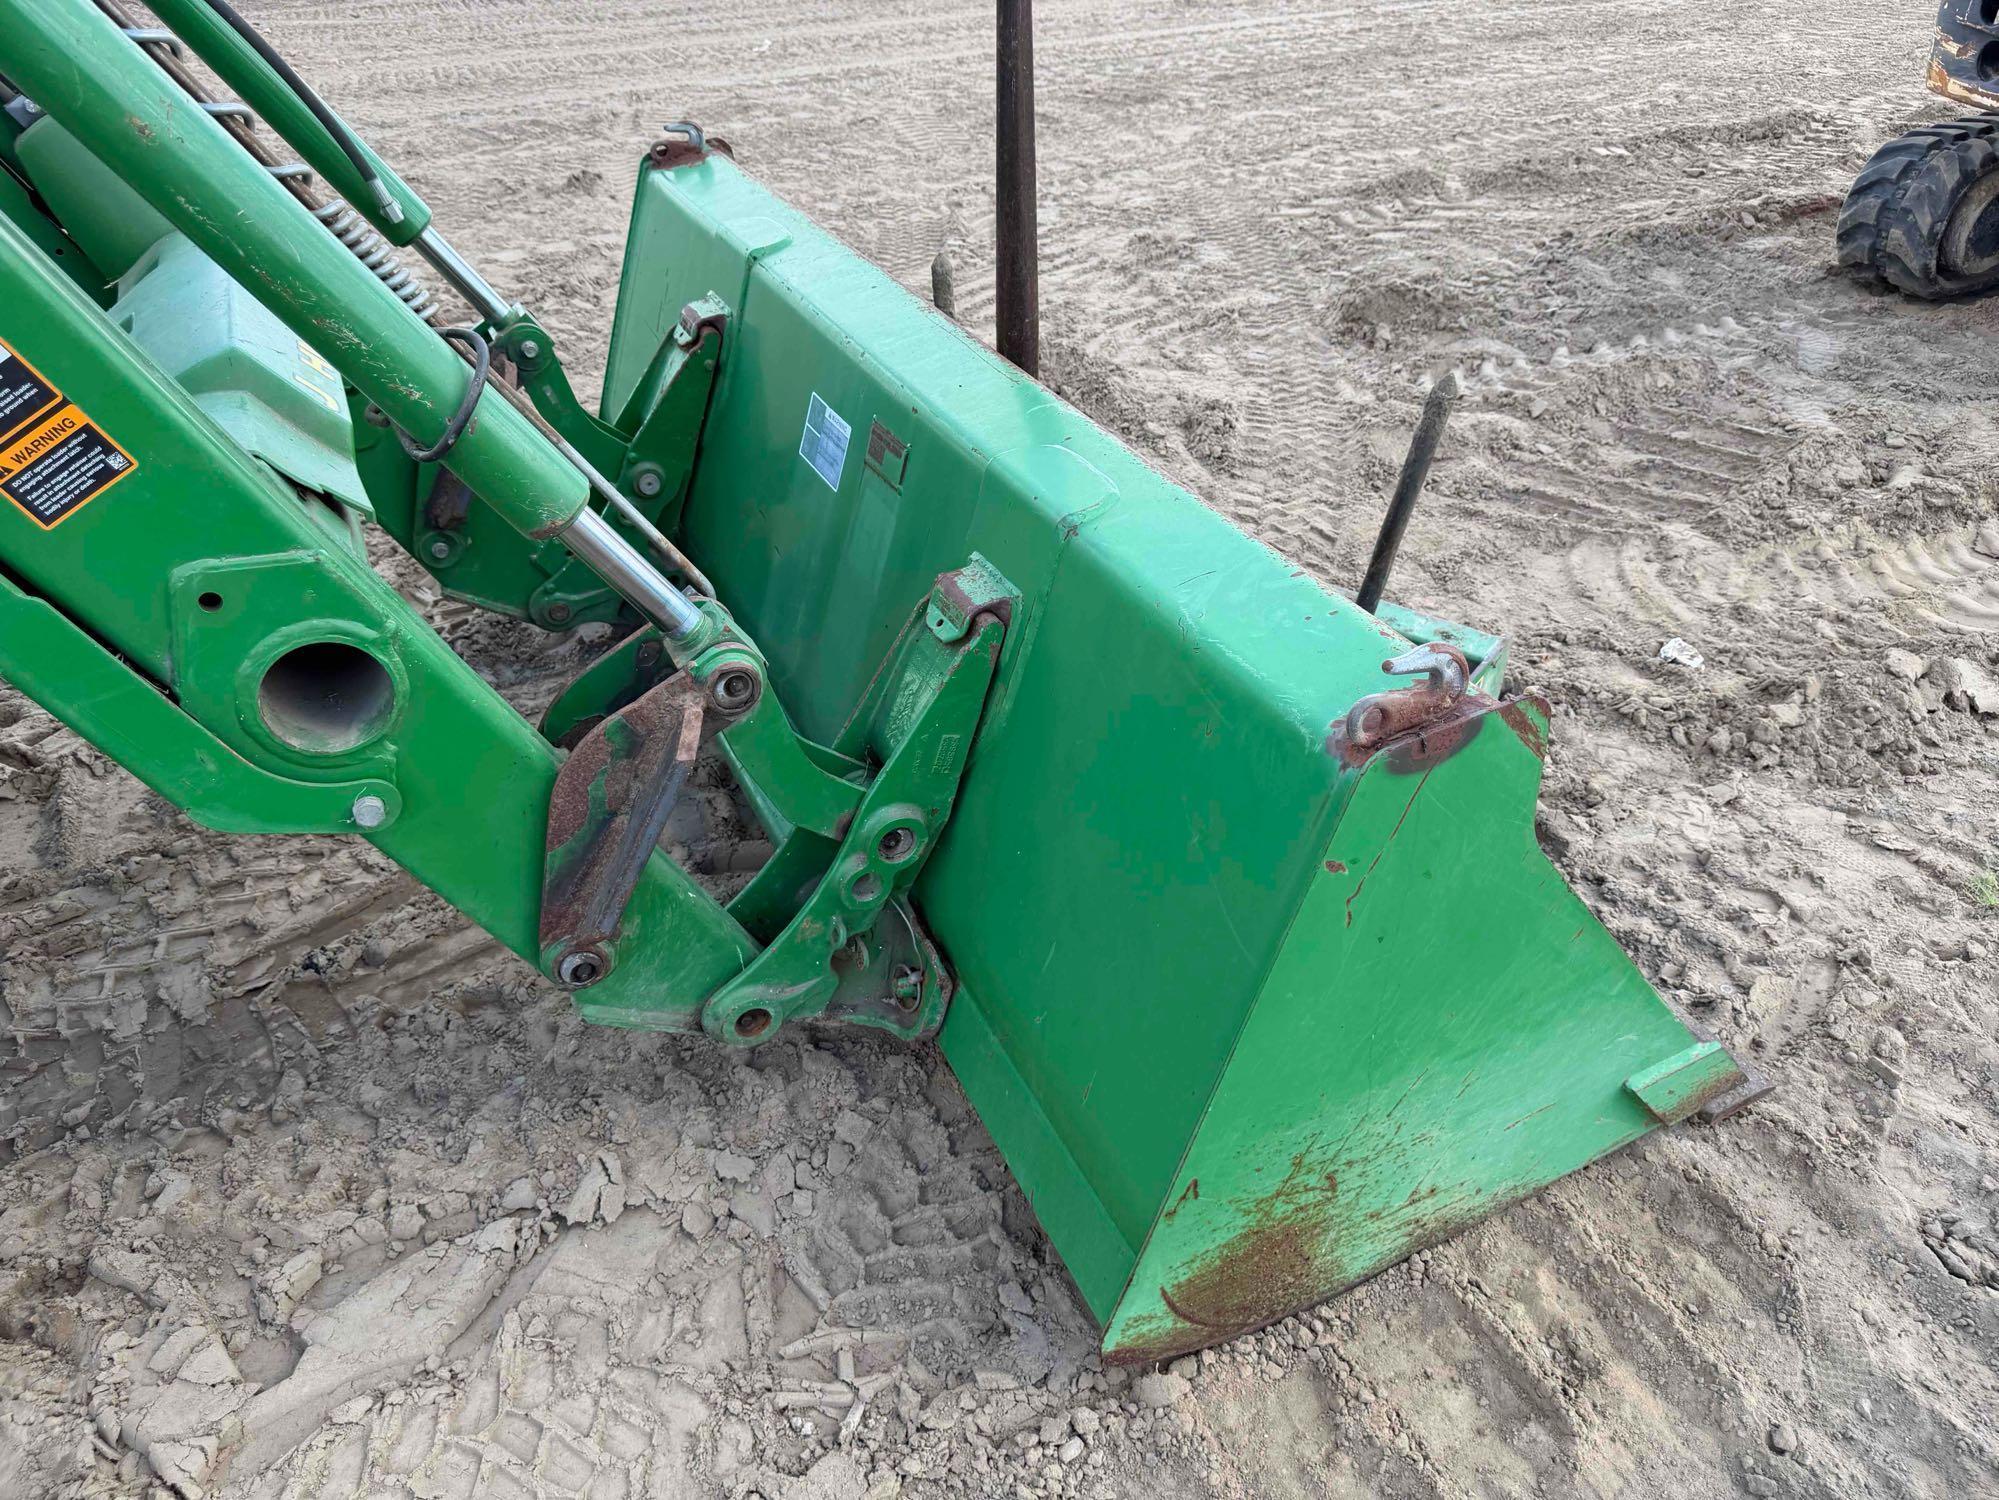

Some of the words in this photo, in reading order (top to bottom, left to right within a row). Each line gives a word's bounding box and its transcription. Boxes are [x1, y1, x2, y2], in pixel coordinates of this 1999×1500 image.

[4, 397, 24, 414] ground
[22, 387, 39, 400] when
[10, 417, 77, 464] WARNING
[12, 479, 22, 487] DO
[21, 470, 34, 481] NOT
[33, 457, 54, 474] operate
[51, 446, 69, 459] loader
[67, 432, 87, 448] without
[18, 475, 43, 493] engaging
[40, 454, 70, 476] attachment
[68, 444, 84, 457] latch.
[27, 486, 45, 500] Failure
[50, 470, 70, 485] engage
[68, 456, 88, 471] retainer
[86, 445, 103, 458] could
[33, 493, 48, 505] result
[52, 470, 81, 491] attachment
[79, 452, 106, 473] detaching
[39, 500, 52, 510] from
[50, 488, 67, 502] loader
[66, 475, 87, 491] causing
[85, 462, 105, 477] serious
[44, 502, 61, 516] bodily
[60, 492, 75, 505] injury
[79, 477, 96, 490] death.
